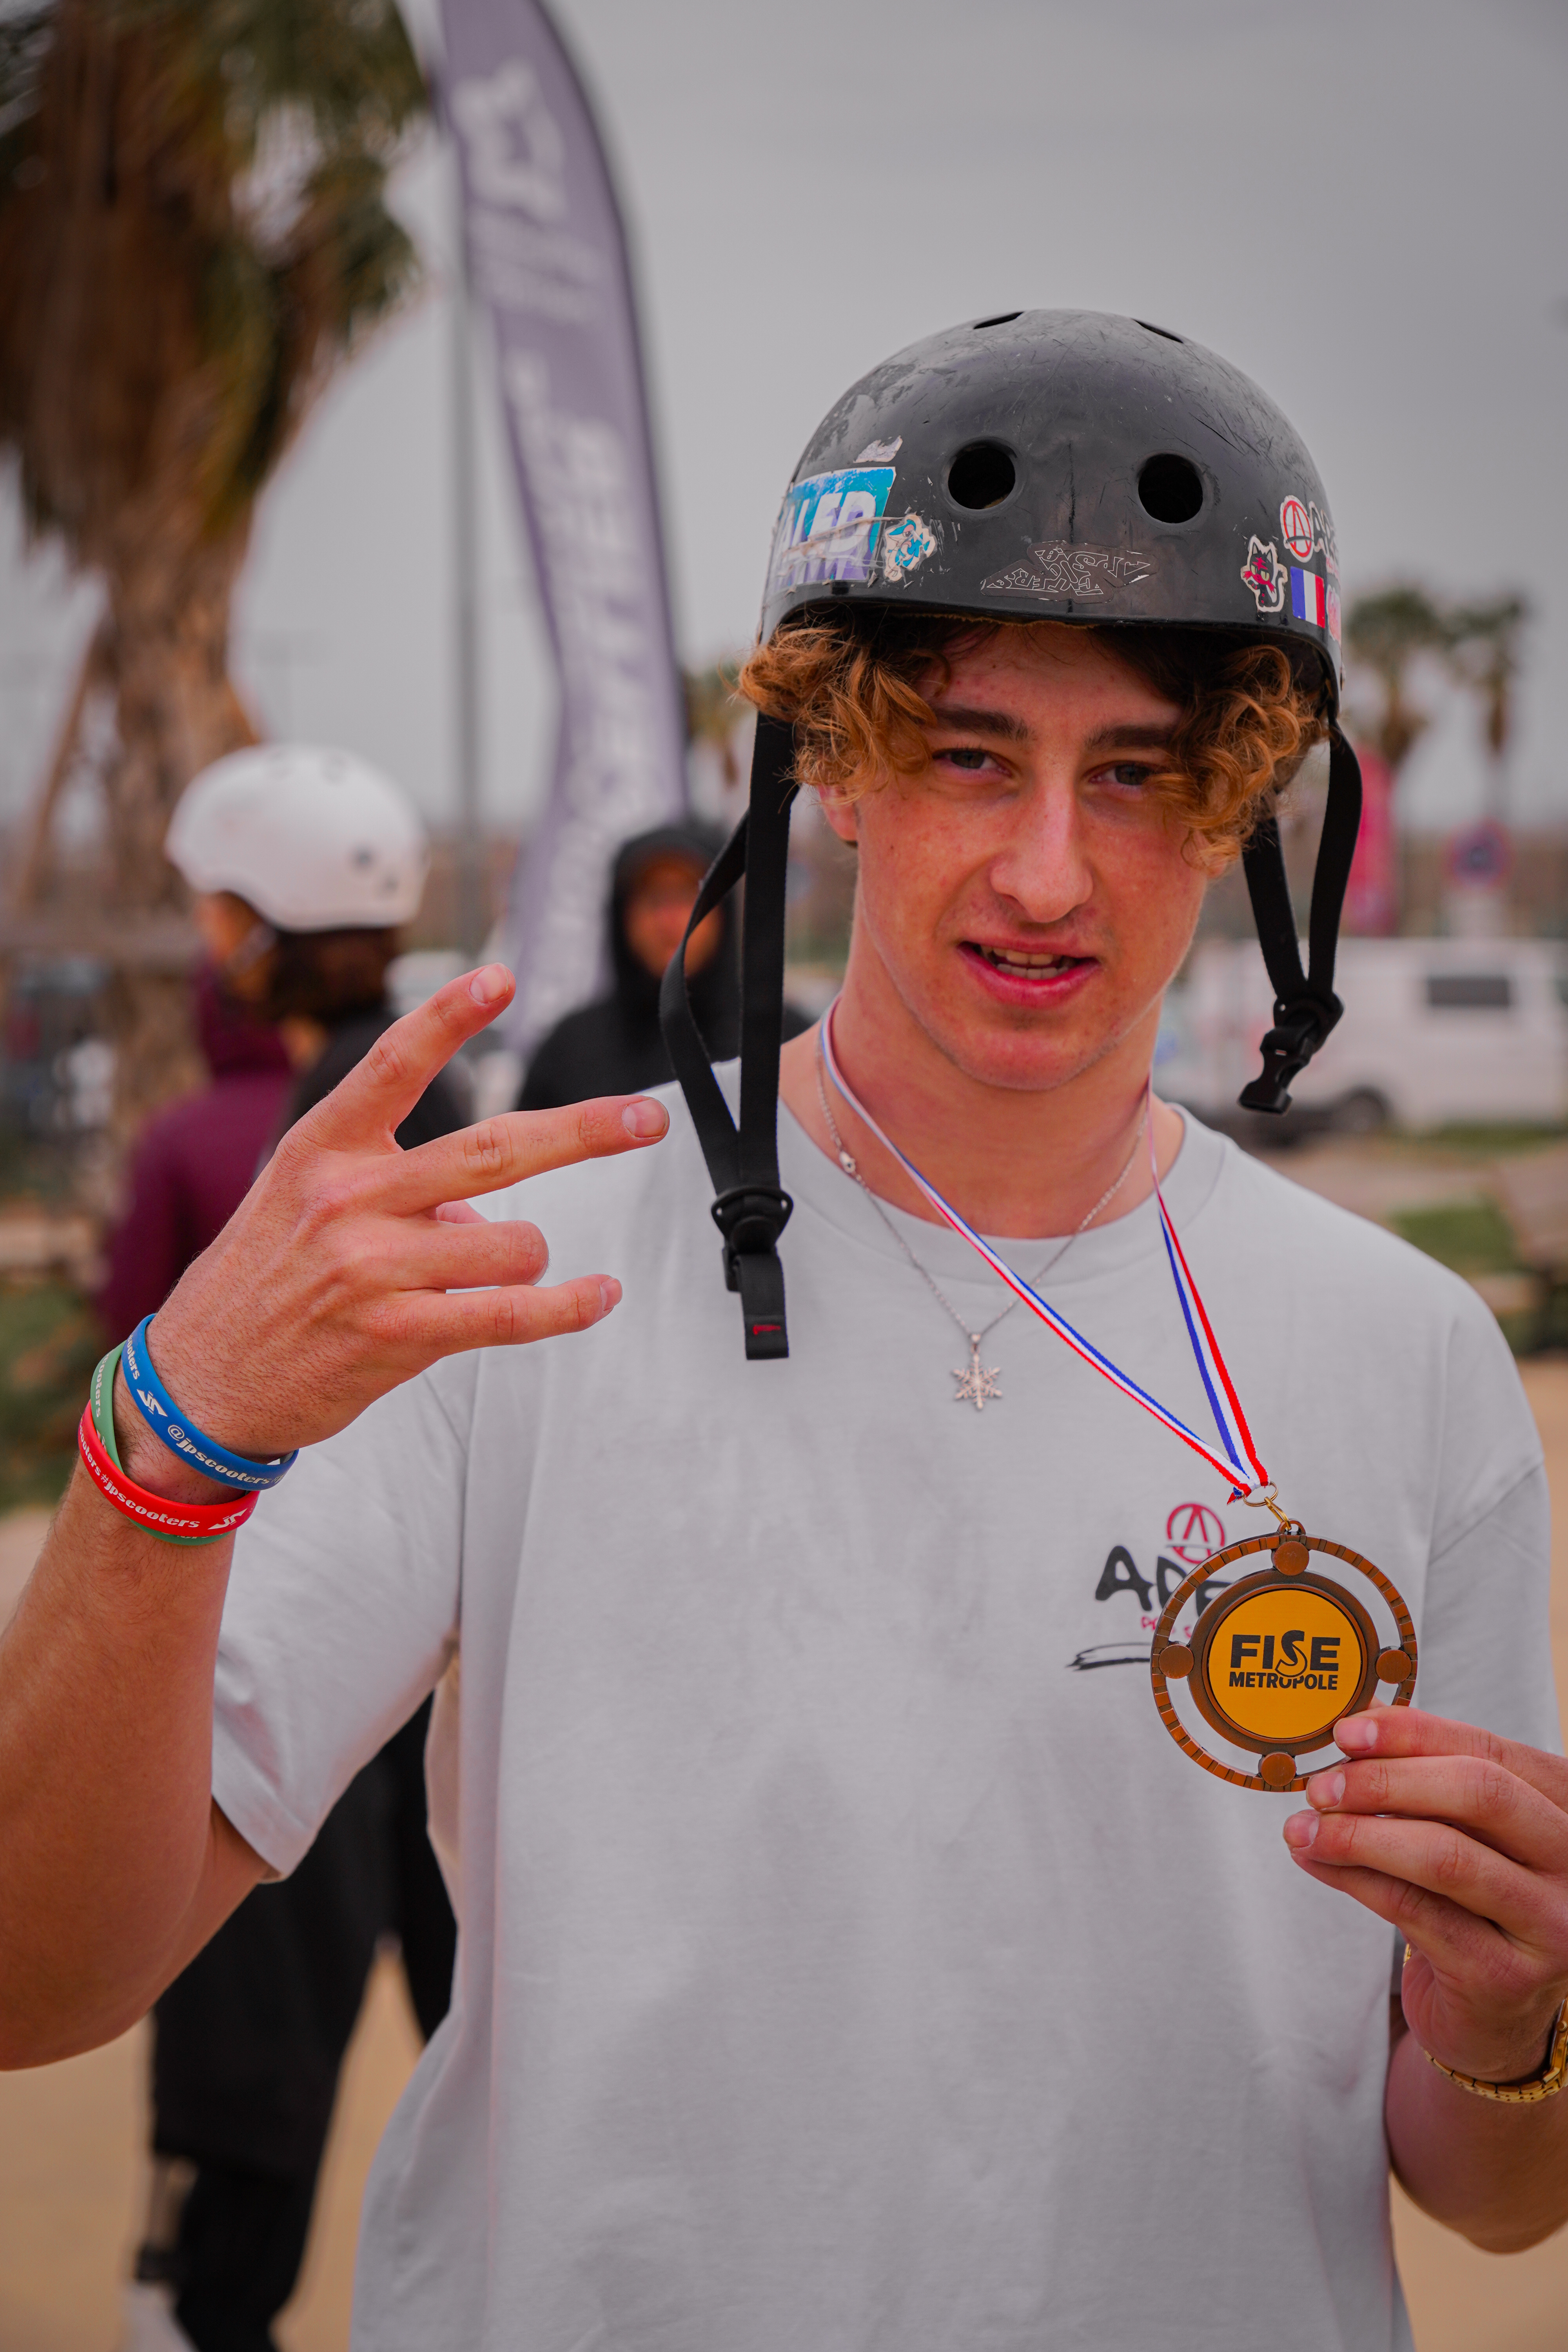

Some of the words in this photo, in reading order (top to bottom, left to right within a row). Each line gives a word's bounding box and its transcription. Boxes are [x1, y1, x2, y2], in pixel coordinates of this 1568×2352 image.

[167, 1425, 272, 1484] @jpscooters
[101, 1474, 200, 1528] #jpscooters
[1230, 1630, 1341, 1678] FISE
[1229, 1671, 1338, 1690] METROPOLE
